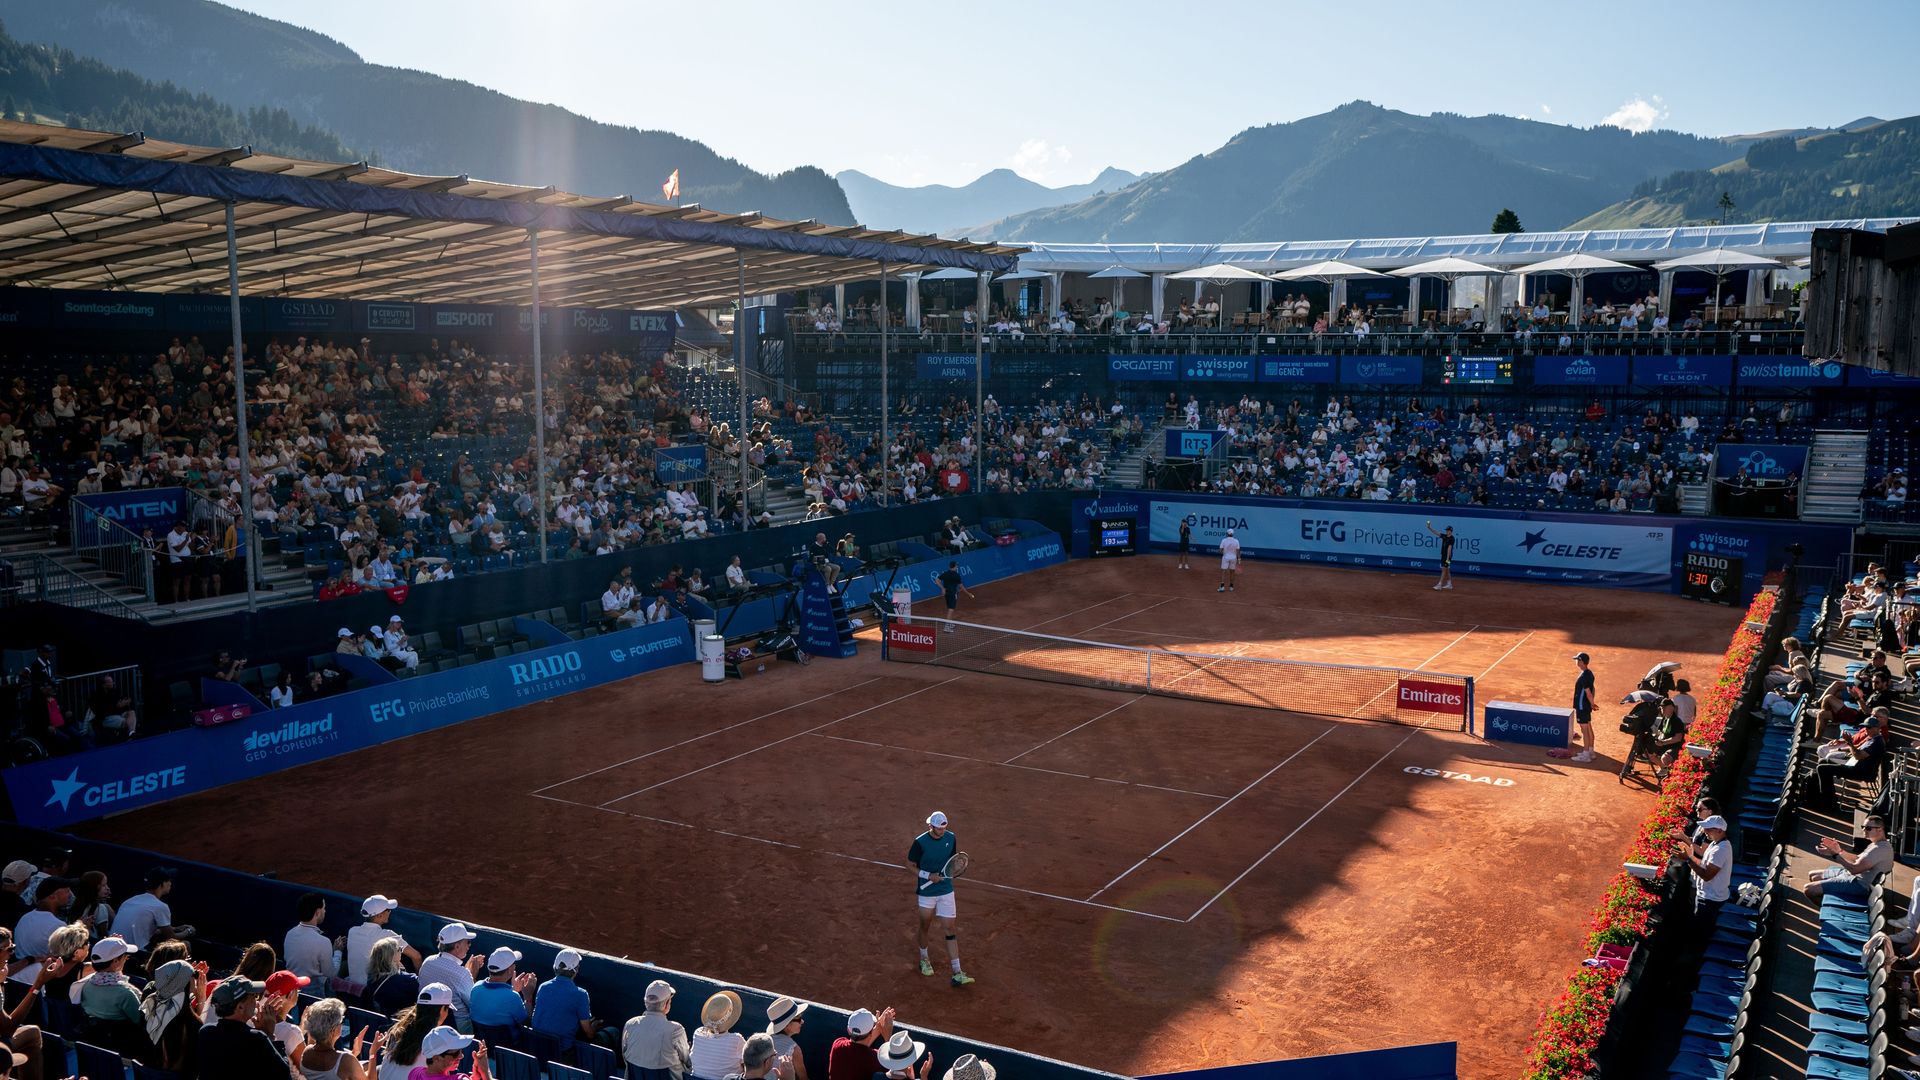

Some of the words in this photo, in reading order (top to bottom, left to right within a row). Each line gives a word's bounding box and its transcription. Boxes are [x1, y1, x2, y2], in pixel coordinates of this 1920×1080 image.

[65, 302, 154, 317] SonntagsZeitung
[282, 304, 335, 316] GSTAAD
[450, 312, 494, 327] SPORT
[928, 356, 943, 365] ROY
[1112, 360, 1174, 370] ORGATENT
[1197, 358, 1249, 371] swisspor
[942, 368, 967, 377] ARENA
[1278, 367, 1305, 376] GENÈVE
[1565, 365, 1596, 375] evian
[1656, 373, 1709, 381] TELMONT
[1740, 362, 1821, 378] swisstennis
[1184, 438, 1209, 450] RTS
[1098, 502, 1139, 515] vaudoise
[1200, 515, 1249, 531] PHIDA
[1300, 519, 1346, 543] EFG
[1354, 528, 1409, 546] Private
[1413, 531, 1481, 555] Baning
[1699, 532, 1749, 548] swisspor
[1541, 544, 1623, 561] CELESTE
[1687, 554, 1728, 570] RADO
[1688, 572, 1708, 585] 1:30
[891, 629, 934, 645] Emirates
[629, 635, 682, 657] FOURTEEN
[508, 651, 582, 685] RADO
[516, 672, 586, 697] SWITZERLAND
[369, 699, 406, 722] EFG
[408, 694, 448, 714] Private
[447, 685, 490, 705] Banking
[1401, 687, 1462, 705] Emirates
[242, 712, 333, 751] devillard
[245, 750, 267, 762] GED
[275, 735, 323, 755] COPIEURS
[330, 731, 339, 741] IT
[1403, 766, 1517, 787] GSTAAD
[84, 765, 187, 807] CELESTE
